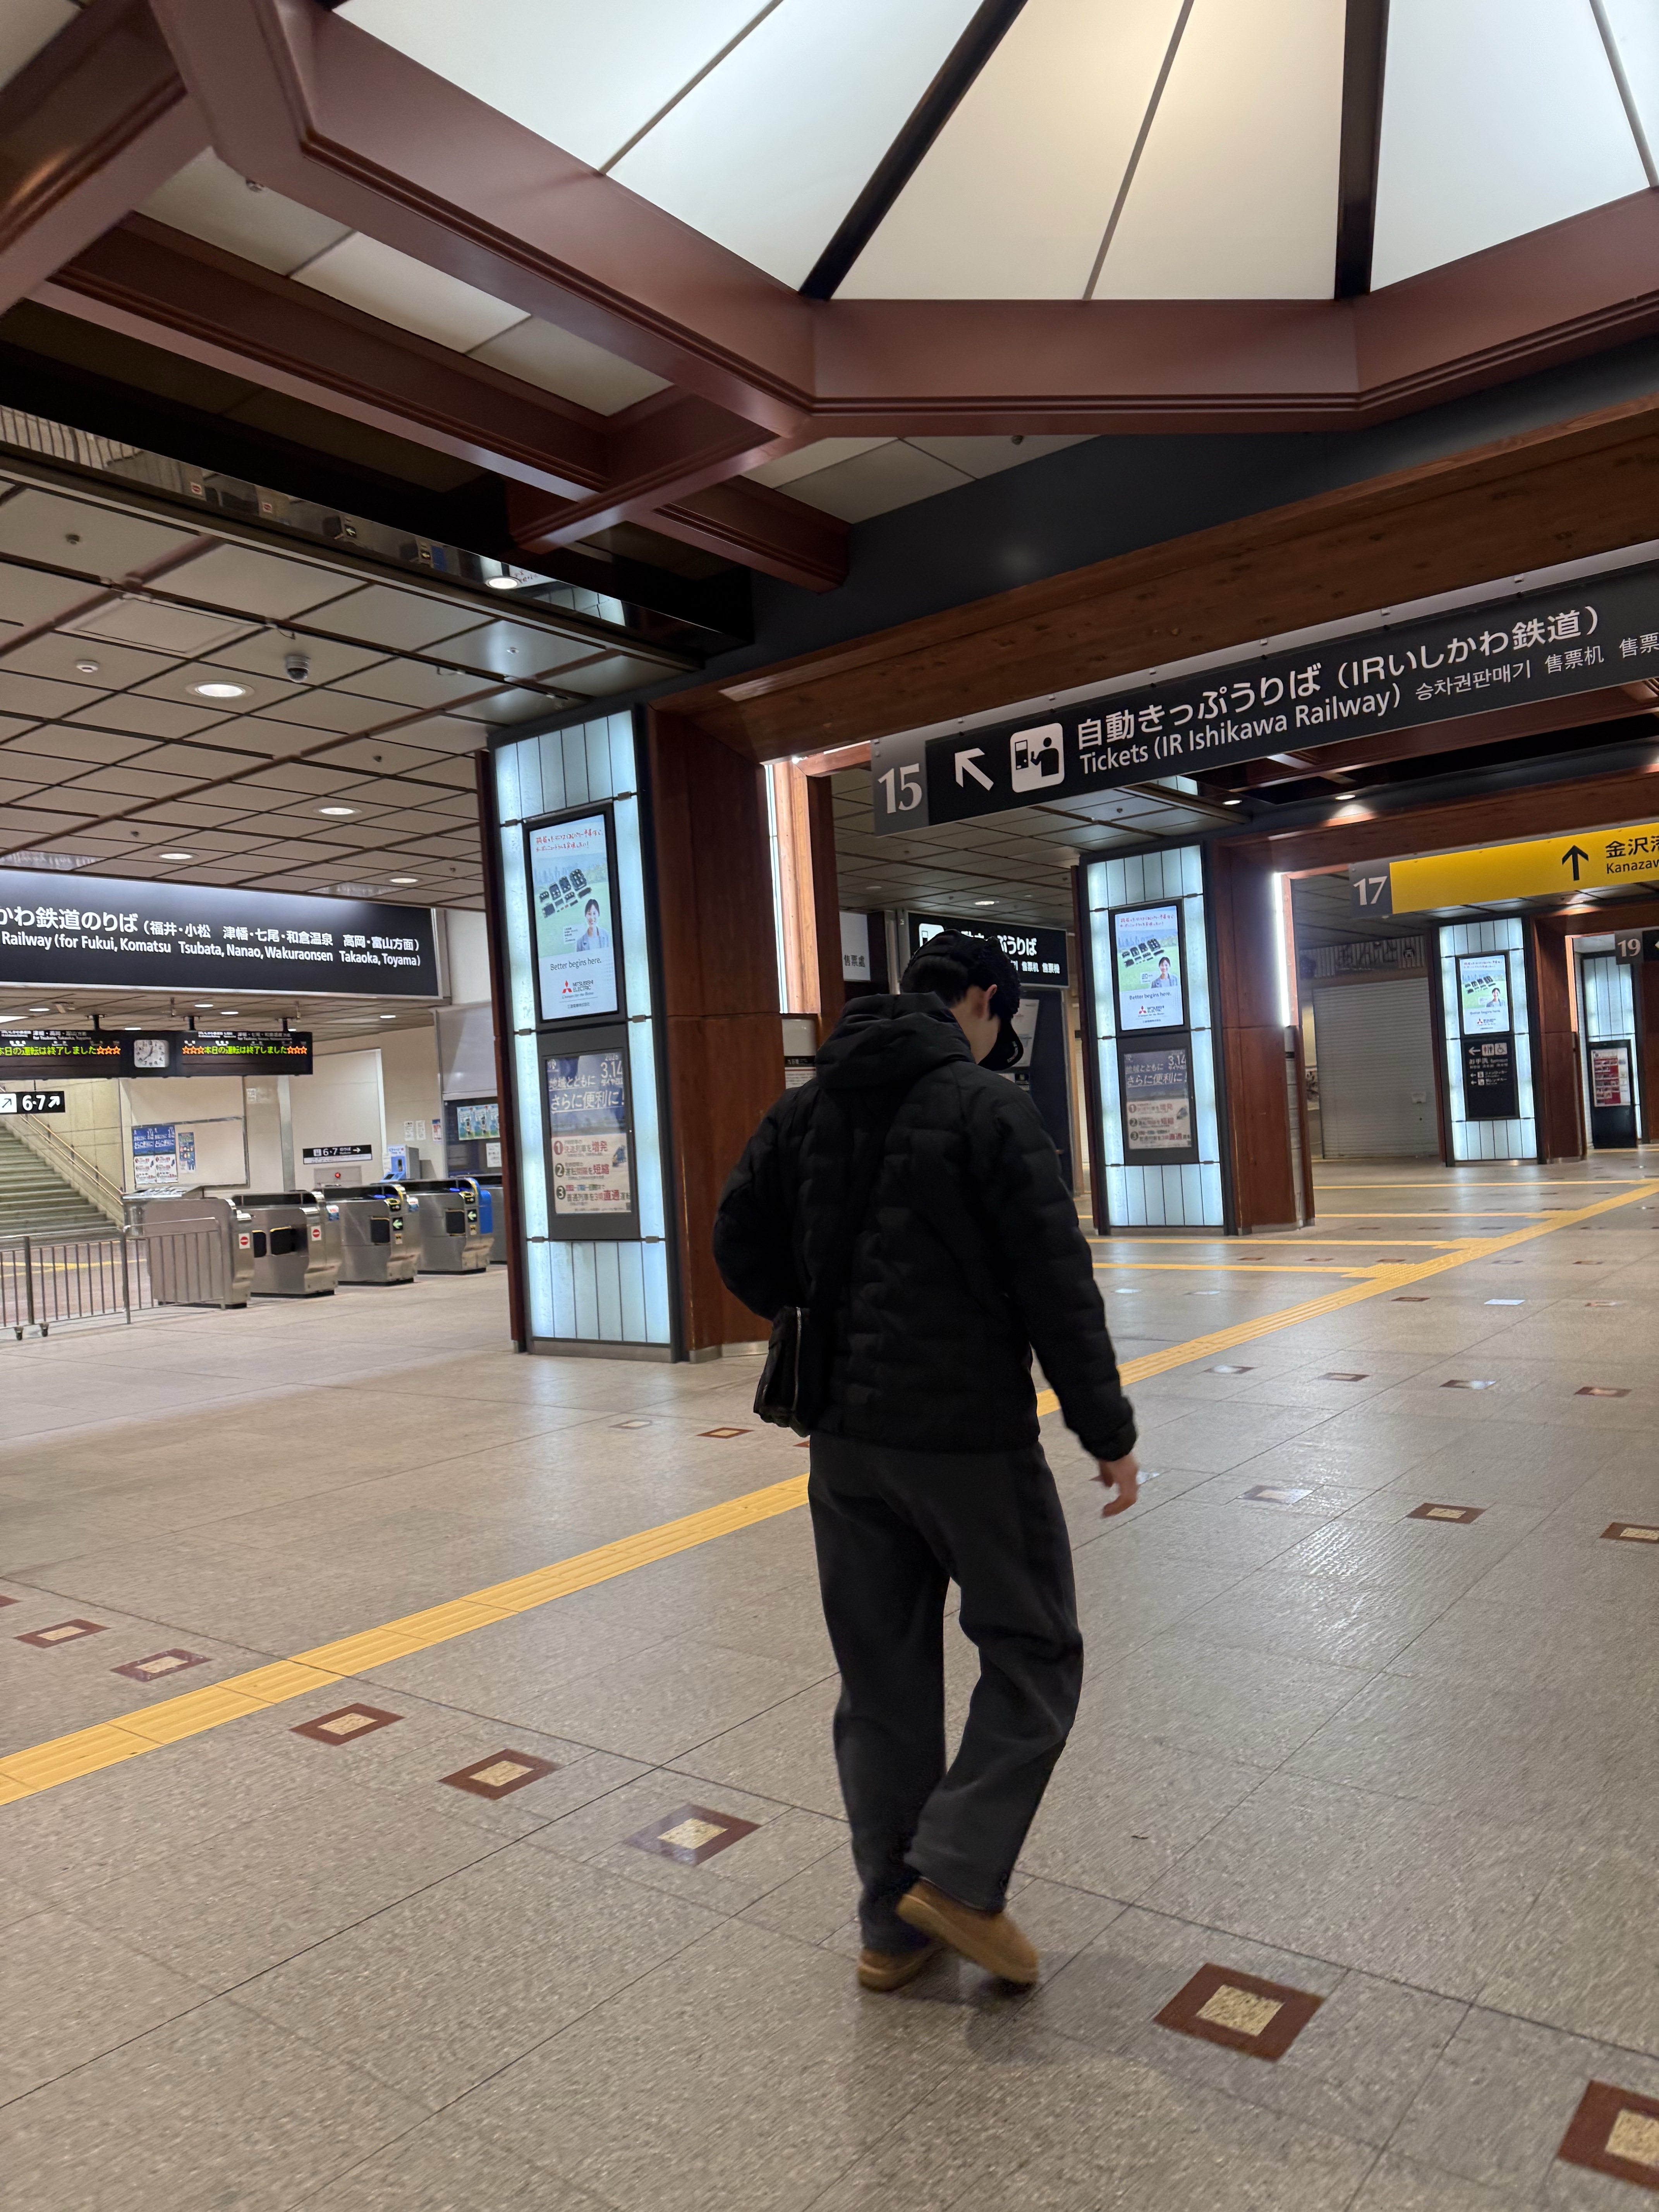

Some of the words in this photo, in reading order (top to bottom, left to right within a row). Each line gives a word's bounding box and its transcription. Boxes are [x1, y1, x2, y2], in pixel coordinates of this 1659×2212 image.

[1544, 645, 1604, 675] 售票机
[1415, 659, 1532, 701] 승차권판매기
[1080, 741, 1149, 775] Tickets
[1154, 734, 1182, 760] (IR
[1189, 715, 1287, 751] Ishikawa
[1295, 683, 1401, 728] Railway)
[878, 763, 923, 814] 15
[1353, 875, 1388, 906] 17
[2, 931, 52, 950] Railway
[54, 933, 79, 949] (for
[82, 936, 118, 952] Fukui,
[120, 938, 171, 953] Komatsu
[178, 941, 225, 958] Tsubata,
[227, 944, 263, 960] Nanao,
[264, 946, 333, 962] Wakuraonsen
[339, 950, 381, 966] Takaoka,
[382, 953, 421, 968] Toyama)
[568, 959, 587, 969] begins
[1617, 938, 1641, 957] 19
